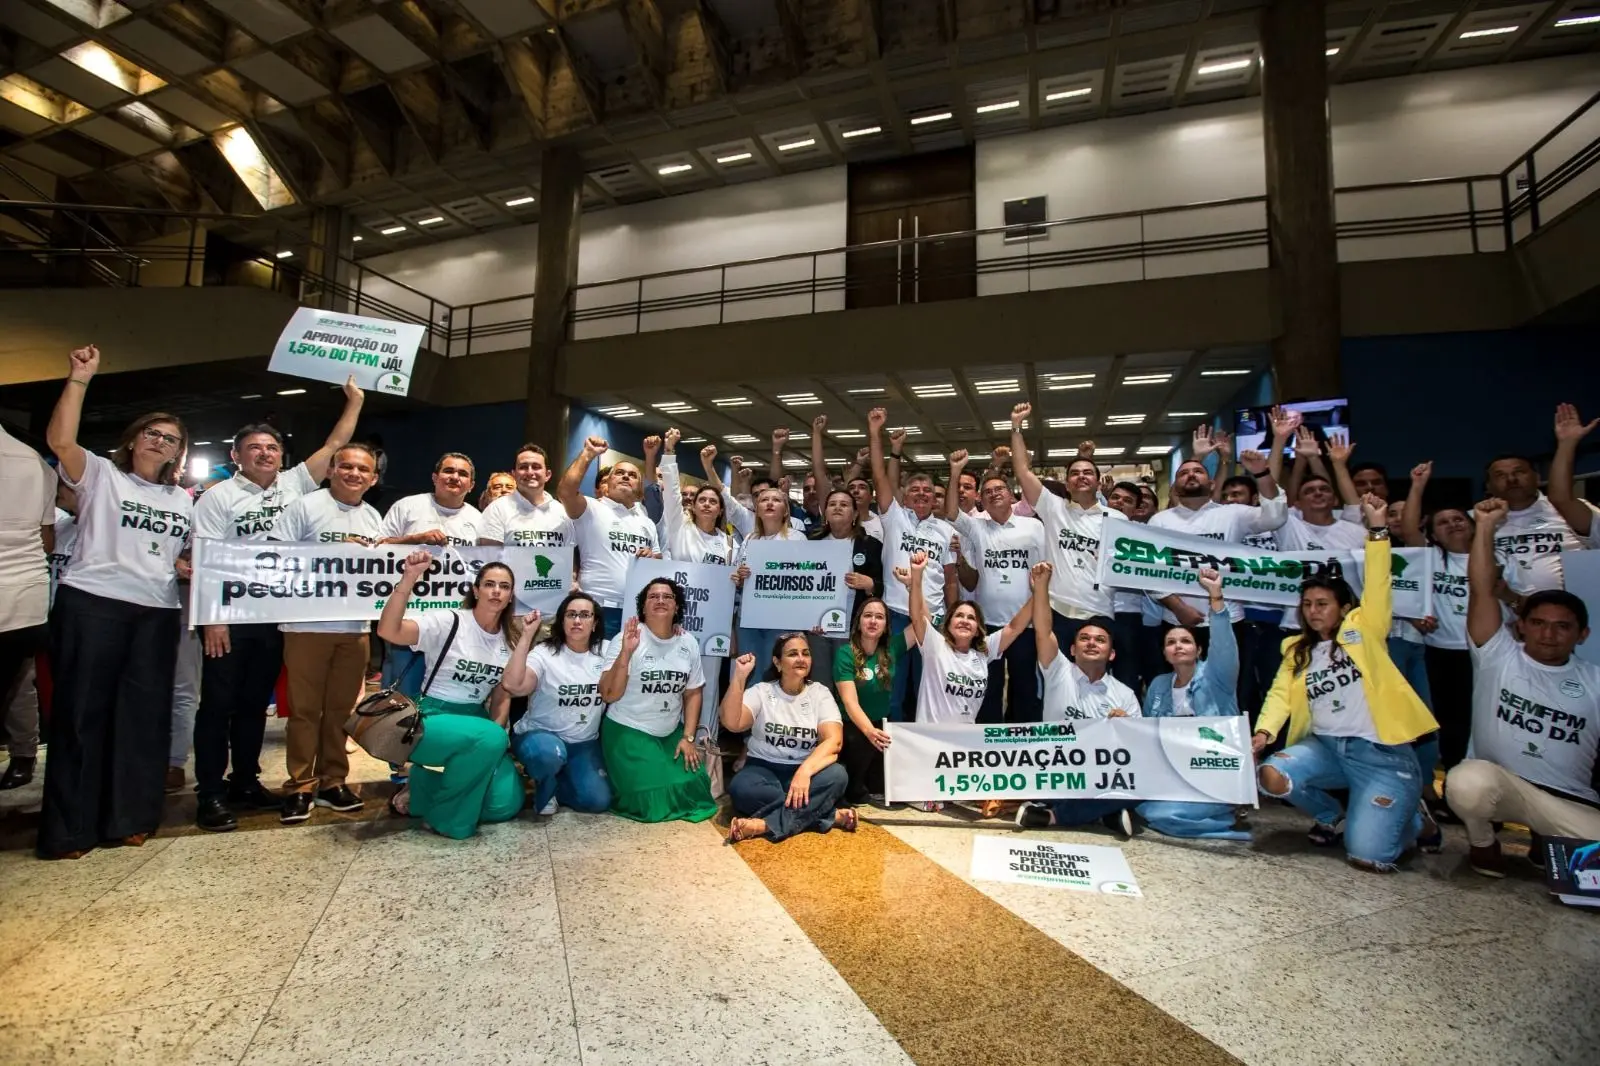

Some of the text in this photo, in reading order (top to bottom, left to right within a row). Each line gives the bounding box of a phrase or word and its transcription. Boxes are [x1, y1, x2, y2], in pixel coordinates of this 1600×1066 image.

[303, 330, 379, 351] APROVAÇÃO
[380, 342, 399, 354] DO
[288, 341, 403, 372] 1,5% DO FPM JÁ!
[121, 515, 167, 537] NÃO
[236, 519, 274, 536] NÃO
[514, 530, 563, 542] SEMFPM
[1497, 533, 1564, 546] EMFPM
[611, 541, 637, 554] NÃO
[984, 549, 1029, 559] SEMFPM
[1535, 542, 1562, 553] DÁ
[312, 552, 485, 581] municpios
[984, 558, 1029, 570] NÃO DÁ
[674, 571, 688, 585] OS
[755, 572, 836, 592] RECURSOS JÁ!
[1112, 563, 1132, 575] Os
[1222, 576, 1275, 590] pedem
[1432, 571, 1469, 585] SEMF
[524, 580, 562, 589] APRECE
[1391, 580, 1419, 589] RECE
[1432, 584, 1467, 598] NÃO
[455, 659, 504, 676] SEMFP
[1336, 666, 1363, 687] DÁ
[558, 684, 601, 695] SEMF
[641, 681, 672, 694] NÃO
[945, 684, 974, 698] NÃO
[558, 696, 592, 707] NÃO
[1499, 688, 1587, 730] SEMFPM
[984, 722, 1076, 738] SEMFPMNÃODÁ
[1497, 704, 1580, 745] NÃO DÁ
[765, 735, 798, 748] NÃO
[935, 745, 1131, 771] APROVAÇÃO DO
[1190, 757, 1239, 768] APRECE
[1035, 773, 1086, 790] FPM
[1095, 768, 1135, 790] JÁ!
[1009, 848, 1090, 863] MUNICÍPIOS
[1020, 856, 1076, 869] PEDEM
[1009, 863, 1091, 878] SOCORRO!
